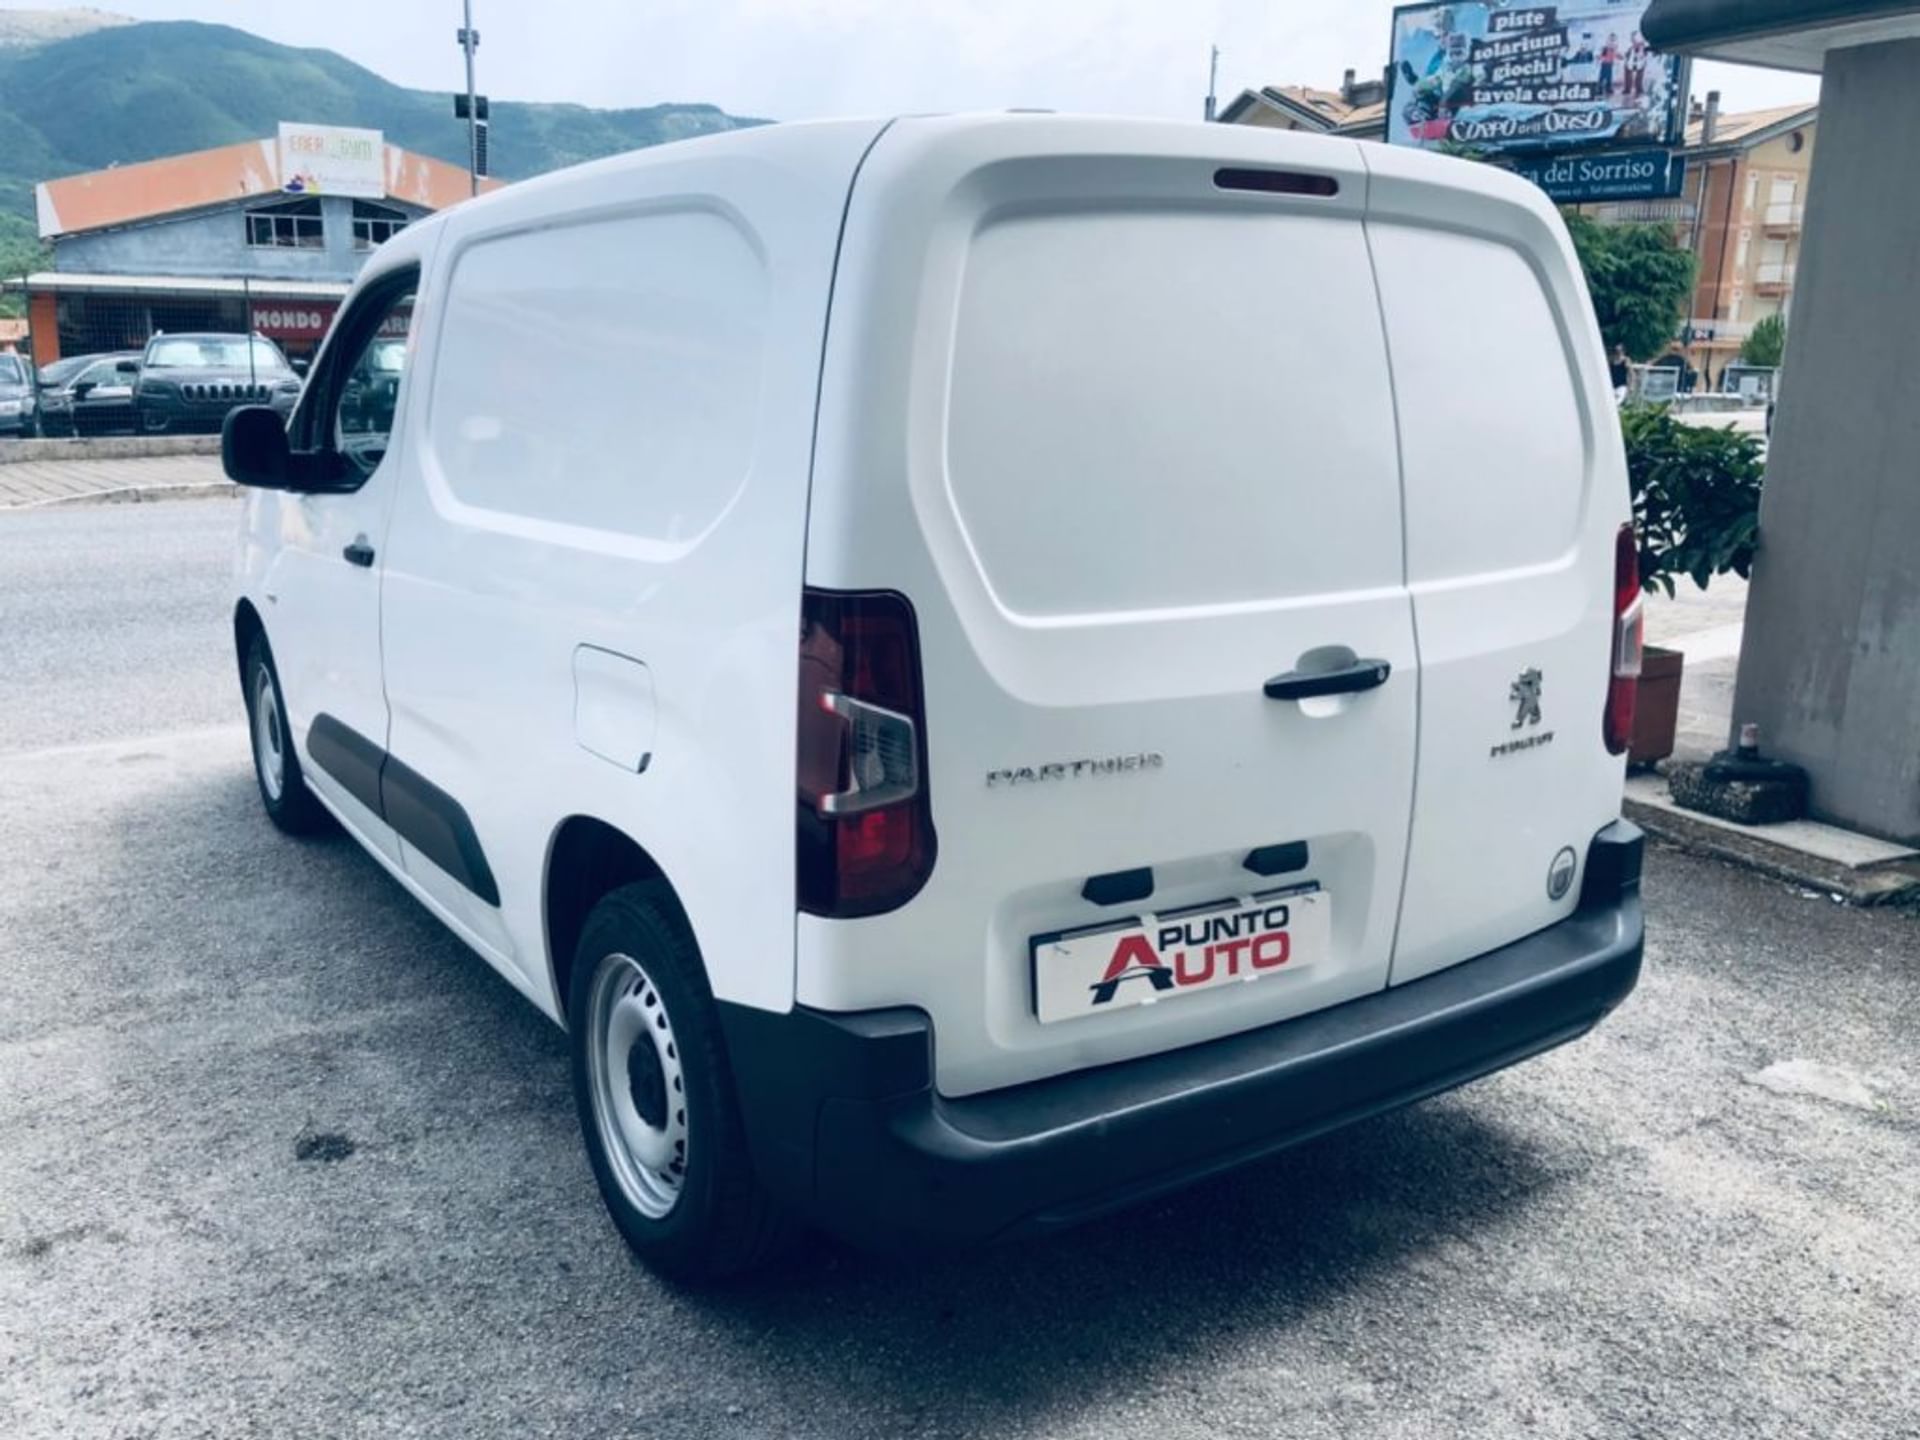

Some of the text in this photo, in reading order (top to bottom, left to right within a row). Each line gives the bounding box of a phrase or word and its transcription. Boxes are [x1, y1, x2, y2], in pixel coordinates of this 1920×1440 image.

[1494, 11, 1545, 32] piste
[1473, 33, 1562, 61] solarium
[1492, 57, 1554, 82] giochi
[1473, 83, 1591, 103] tavola calda
[1544, 161, 1575, 183] del
[1579, 159, 1655, 182] Sorriso
[253, 310, 322, 330] MONDO
[1158, 904, 1290, 951] PUNTO
